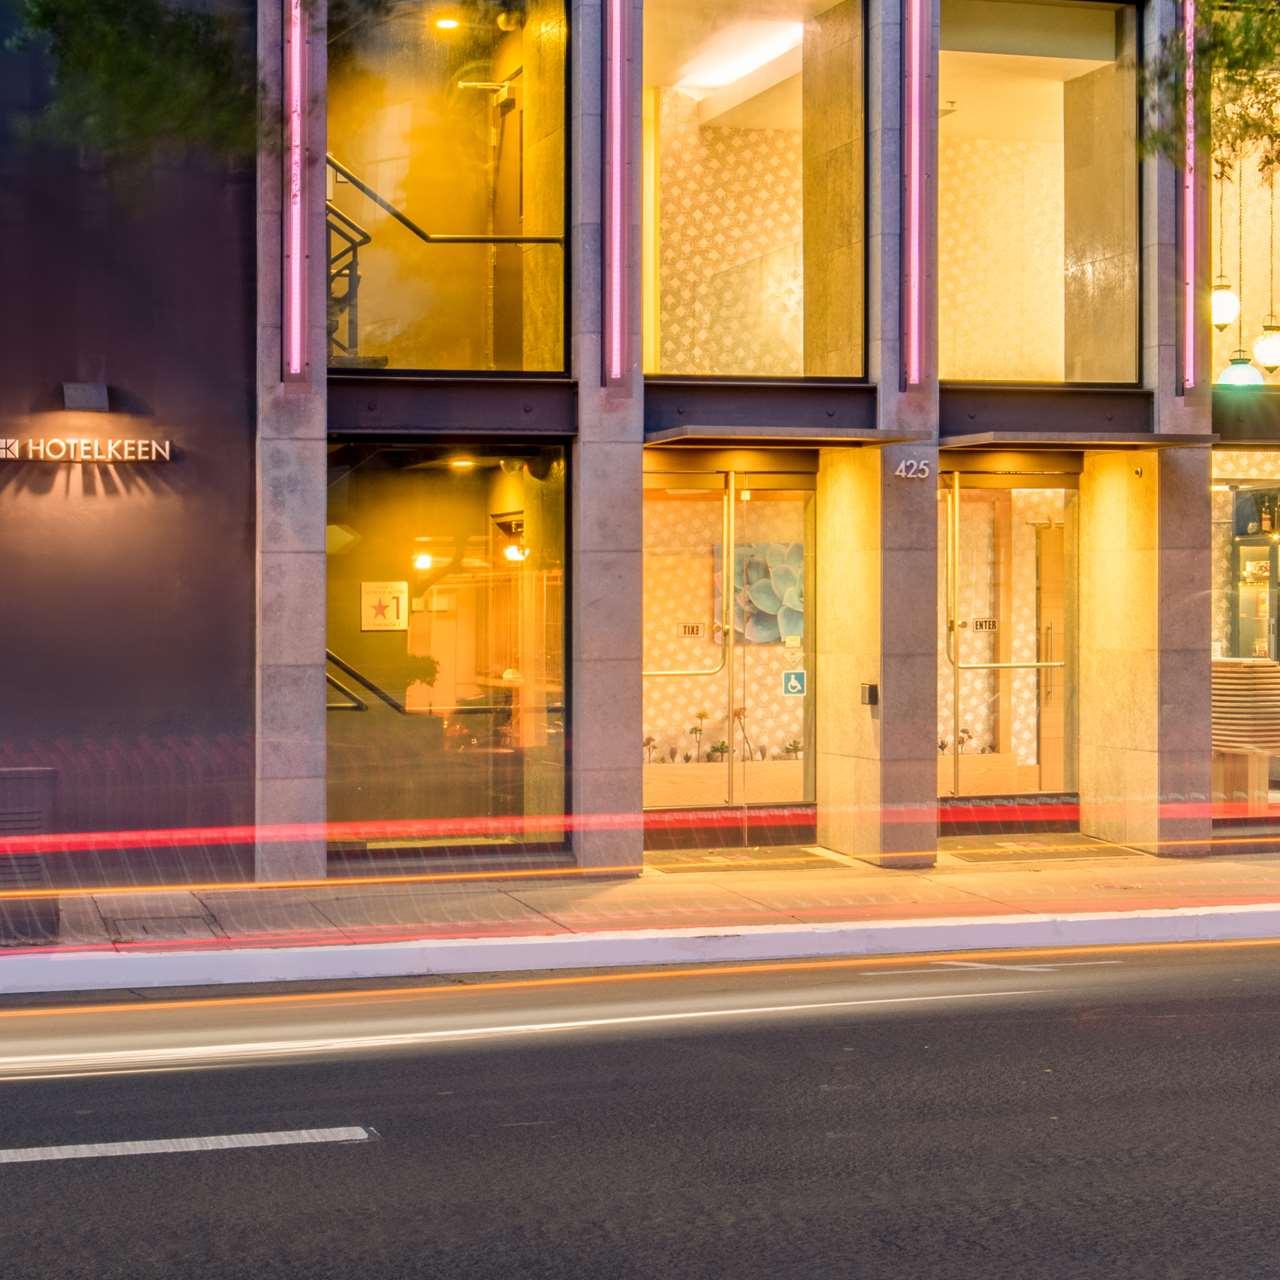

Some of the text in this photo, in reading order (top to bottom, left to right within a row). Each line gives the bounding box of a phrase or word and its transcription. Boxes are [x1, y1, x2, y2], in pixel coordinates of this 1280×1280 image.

[27, 438, 171, 461] HOTELKEEN
[894, 460, 930, 478] 425
[975, 620, 997, 630] ENTER
